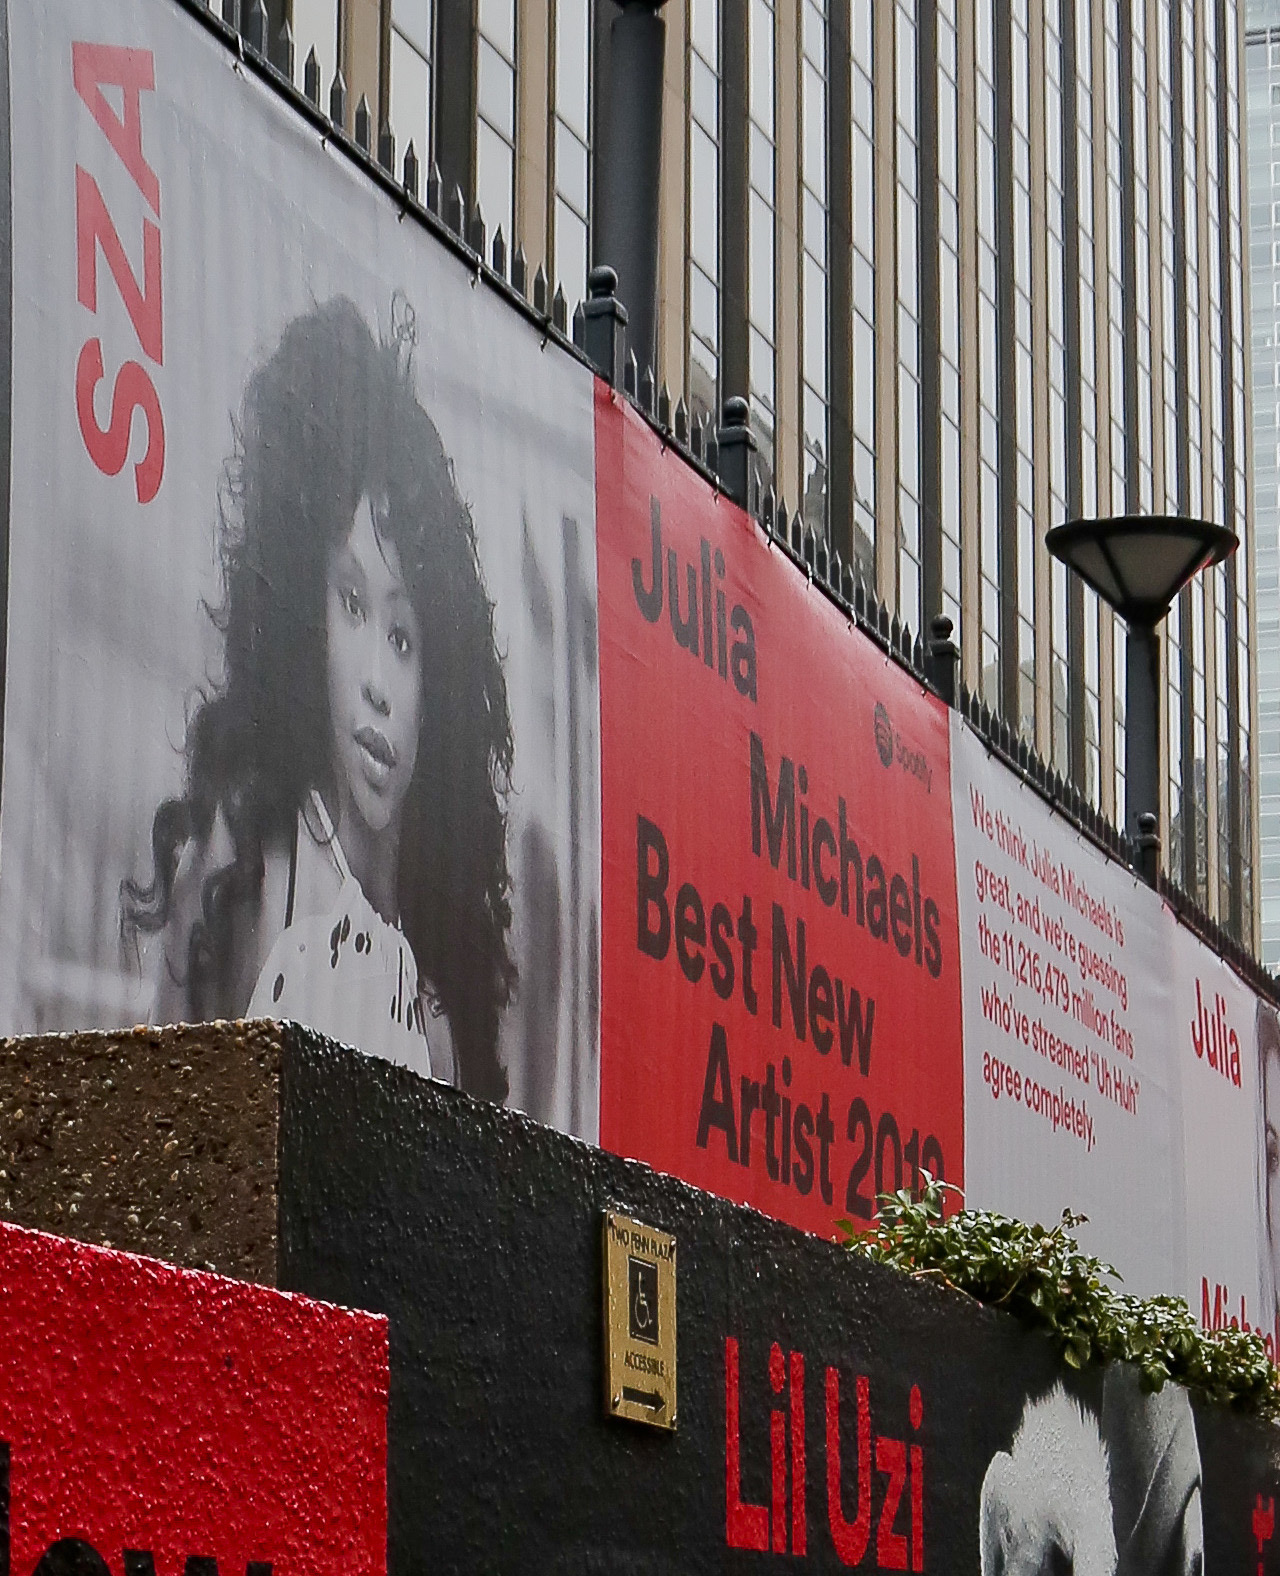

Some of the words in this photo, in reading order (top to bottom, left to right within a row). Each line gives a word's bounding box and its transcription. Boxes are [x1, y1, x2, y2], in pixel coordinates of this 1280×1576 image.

[72, 40, 166, 504] SZA
[631, 494, 757, 705] Julia
[750, 731, 943, 979] Michaels
[969, 781, 994, 841] We
[995, 810, 1029, 870] think
[1031, 839, 1060, 895] Julia
[1061, 862, 1113, 938] Michaels
[1113, 905, 1125, 948] is
[975, 859, 1015, 924] great,
[1017, 893, 1041, 936] and
[1042, 913, 1076, 963] we're
[1078, 942, 1128, 1011] guessing
[636, 813, 758, 1016] Best
[771, 902, 876, 1077] New
[978, 913, 1001, 966] the
[1002, 930, 1069, 1014] 11,216,479
[1072, 987, 1109, 1042] million
[1110, 1009, 1134, 1060] fans
[696, 1021, 835, 1206] Artist
[981, 981, 1029, 1045] who've
[1032, 1018, 1089, 1083] streamed
[983, 1051, 1020, 1101] agree
[1024, 1077, 1096, 1152] completely.
[1190, 977, 1242, 1088] Julia
[624, 1349, 665, 1378] ACCESSIBLE
[725, 1336, 808, 1557] Lil
[825, 1366, 924, 1573] Uzi
